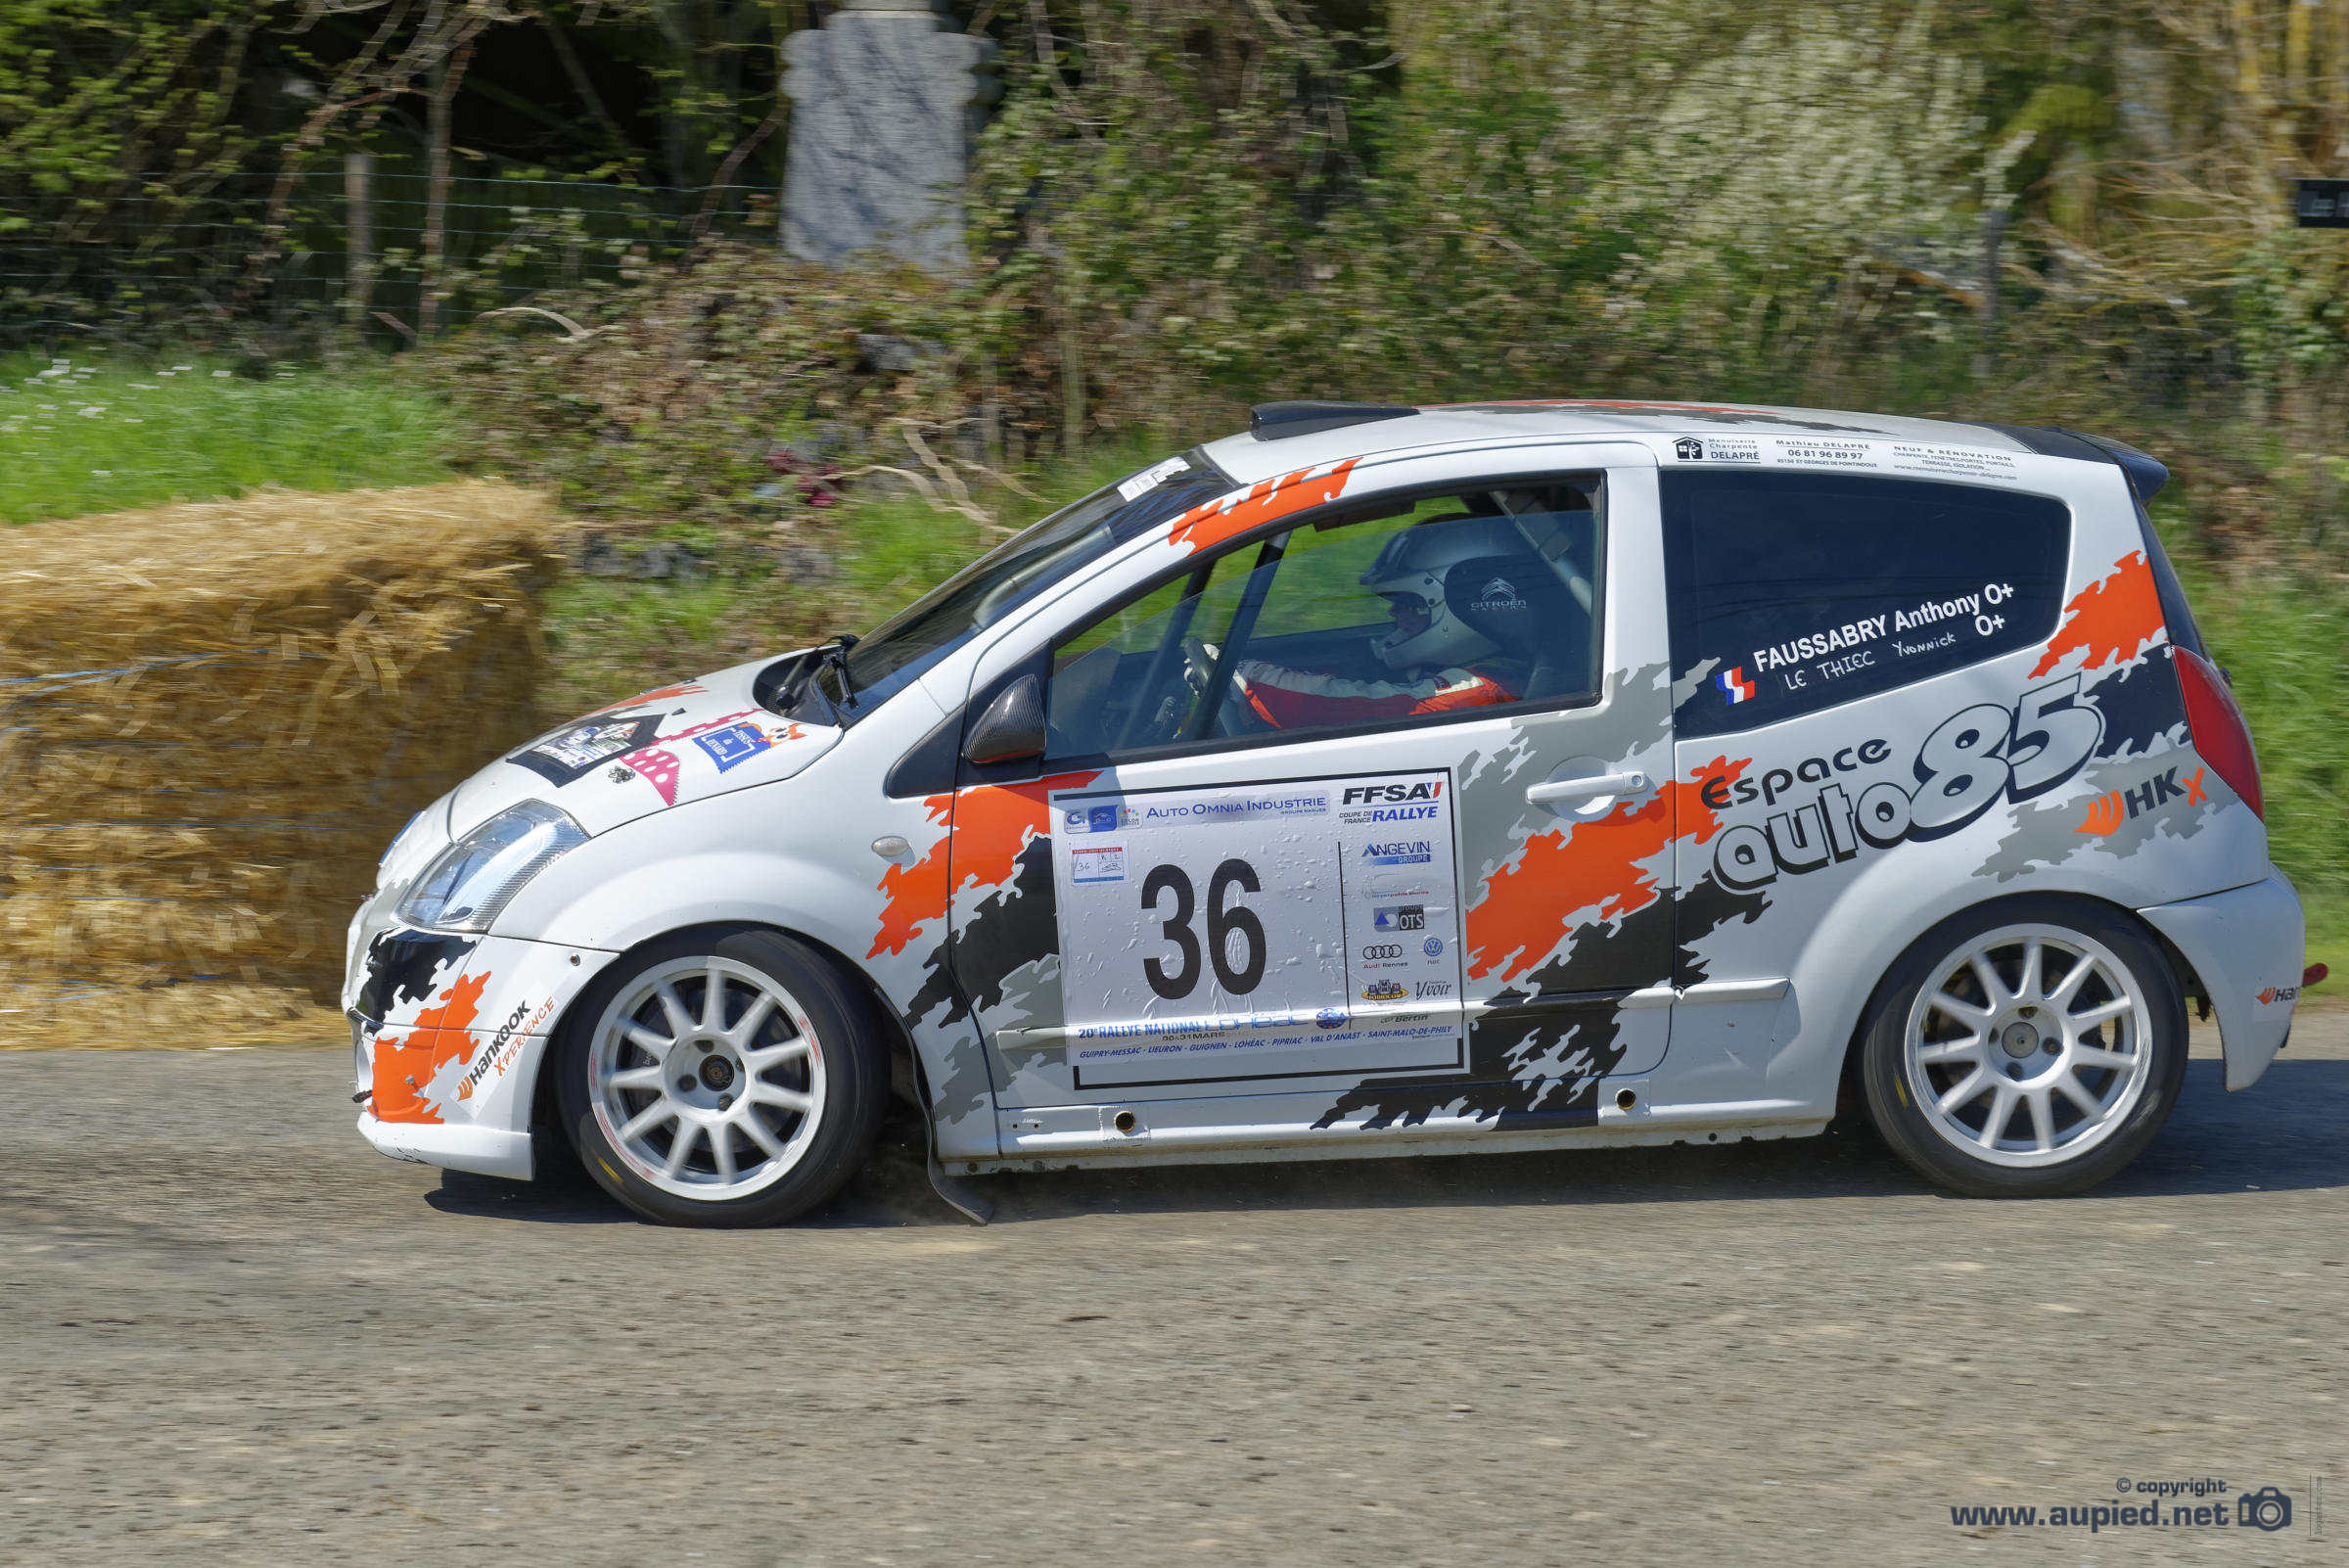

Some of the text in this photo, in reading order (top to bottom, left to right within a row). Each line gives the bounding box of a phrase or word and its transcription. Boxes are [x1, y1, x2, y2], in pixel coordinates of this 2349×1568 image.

[1753, 583, 2014, 672] FAUSSABRY Anthony O+
[1784, 669, 1808, 690] LE
[1817, 650, 1875, 680] THIEC
[1974, 614, 2005, 636] O+
[1700, 738, 1892, 810] Espace
[1343, 783, 1431, 805] FFSA
[1372, 806, 1438, 822] RALLYE
[1139, 857, 1267, 1000] 36
[1399, 914, 1425, 929] OTS
[1080, 1046, 1141, 1059] GUIPRY-MESSAC
[1148, 1044, 1182, 1054] LIEURON
[1189, 1042, 1227, 1052] GUIGNEN
[1272, 1036, 1302, 1045] PIPRIAC
[1367, 1026, 1452, 1038] SAINT-MALO-DE-PHILY
[1099, 1024, 1142, 1038] RALLYE
